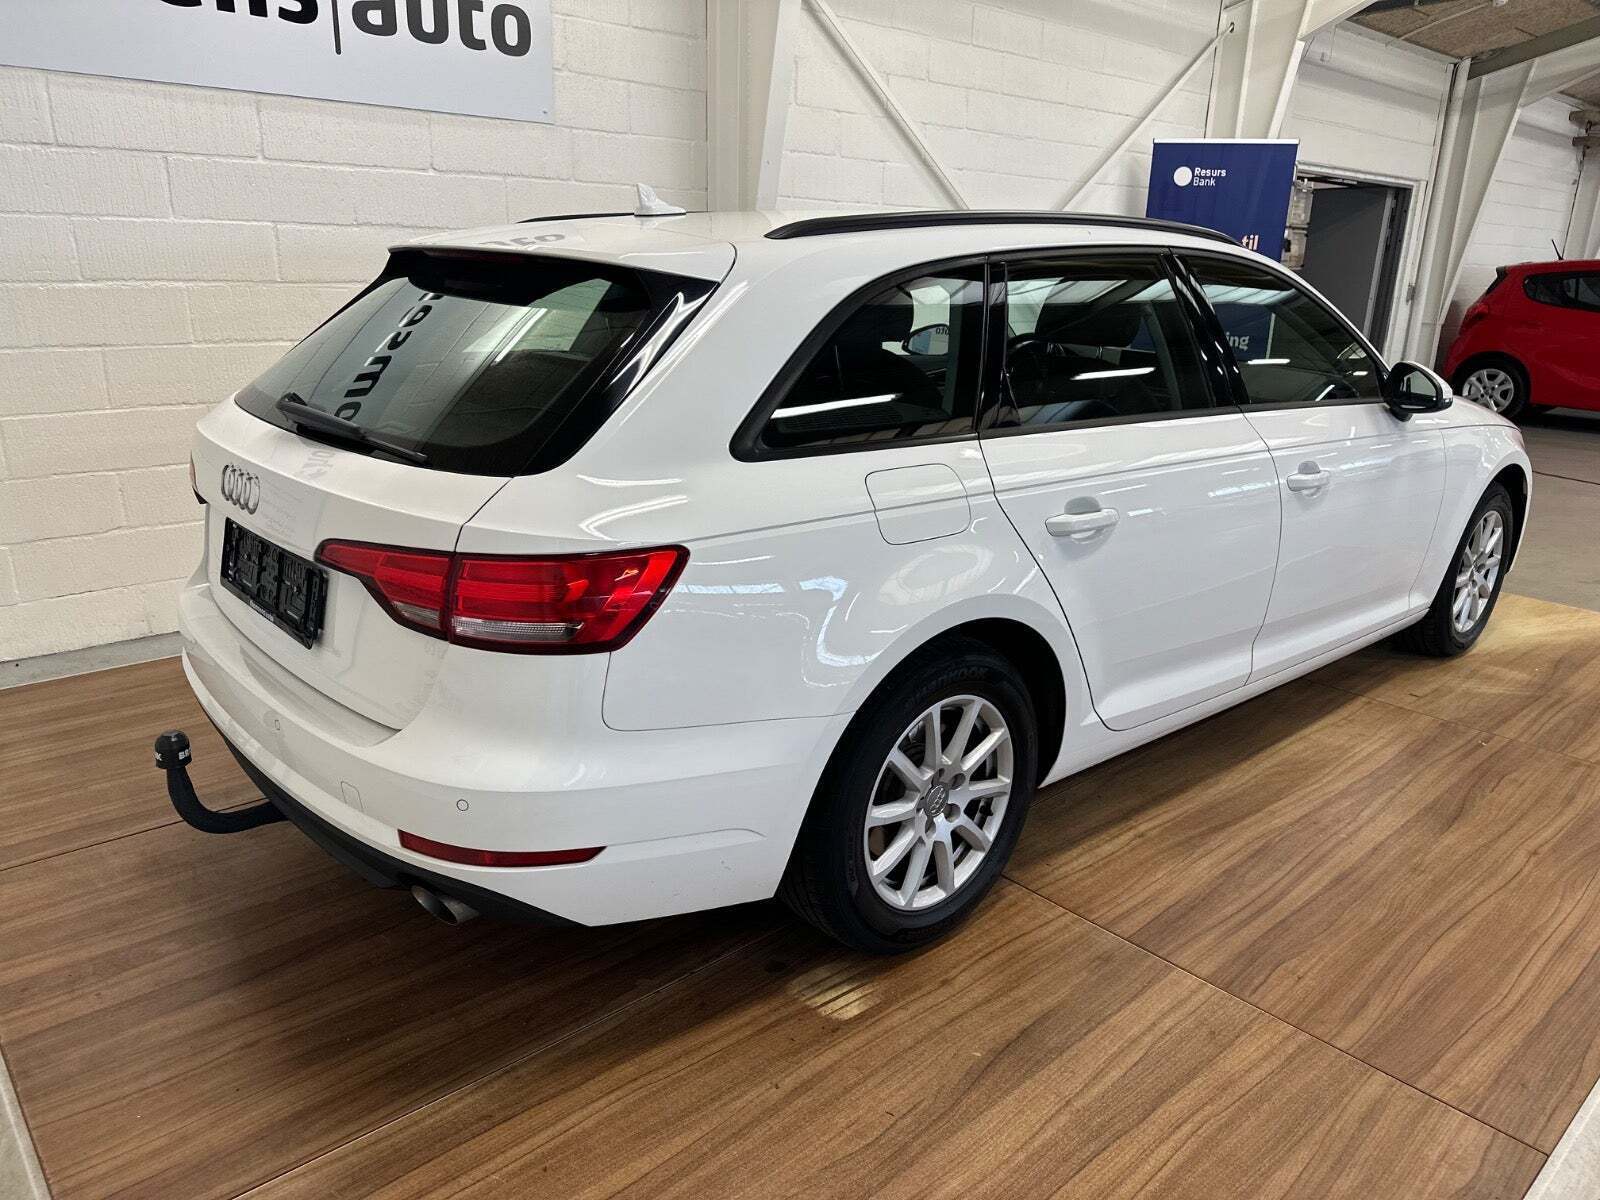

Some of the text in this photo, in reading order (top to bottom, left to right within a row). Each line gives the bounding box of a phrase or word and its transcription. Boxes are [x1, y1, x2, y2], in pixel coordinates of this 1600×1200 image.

[351, 0, 532, 57] auto
[1194, 167, 1227, 177] Resurs
[1193, 176, 1216, 187] Bank
